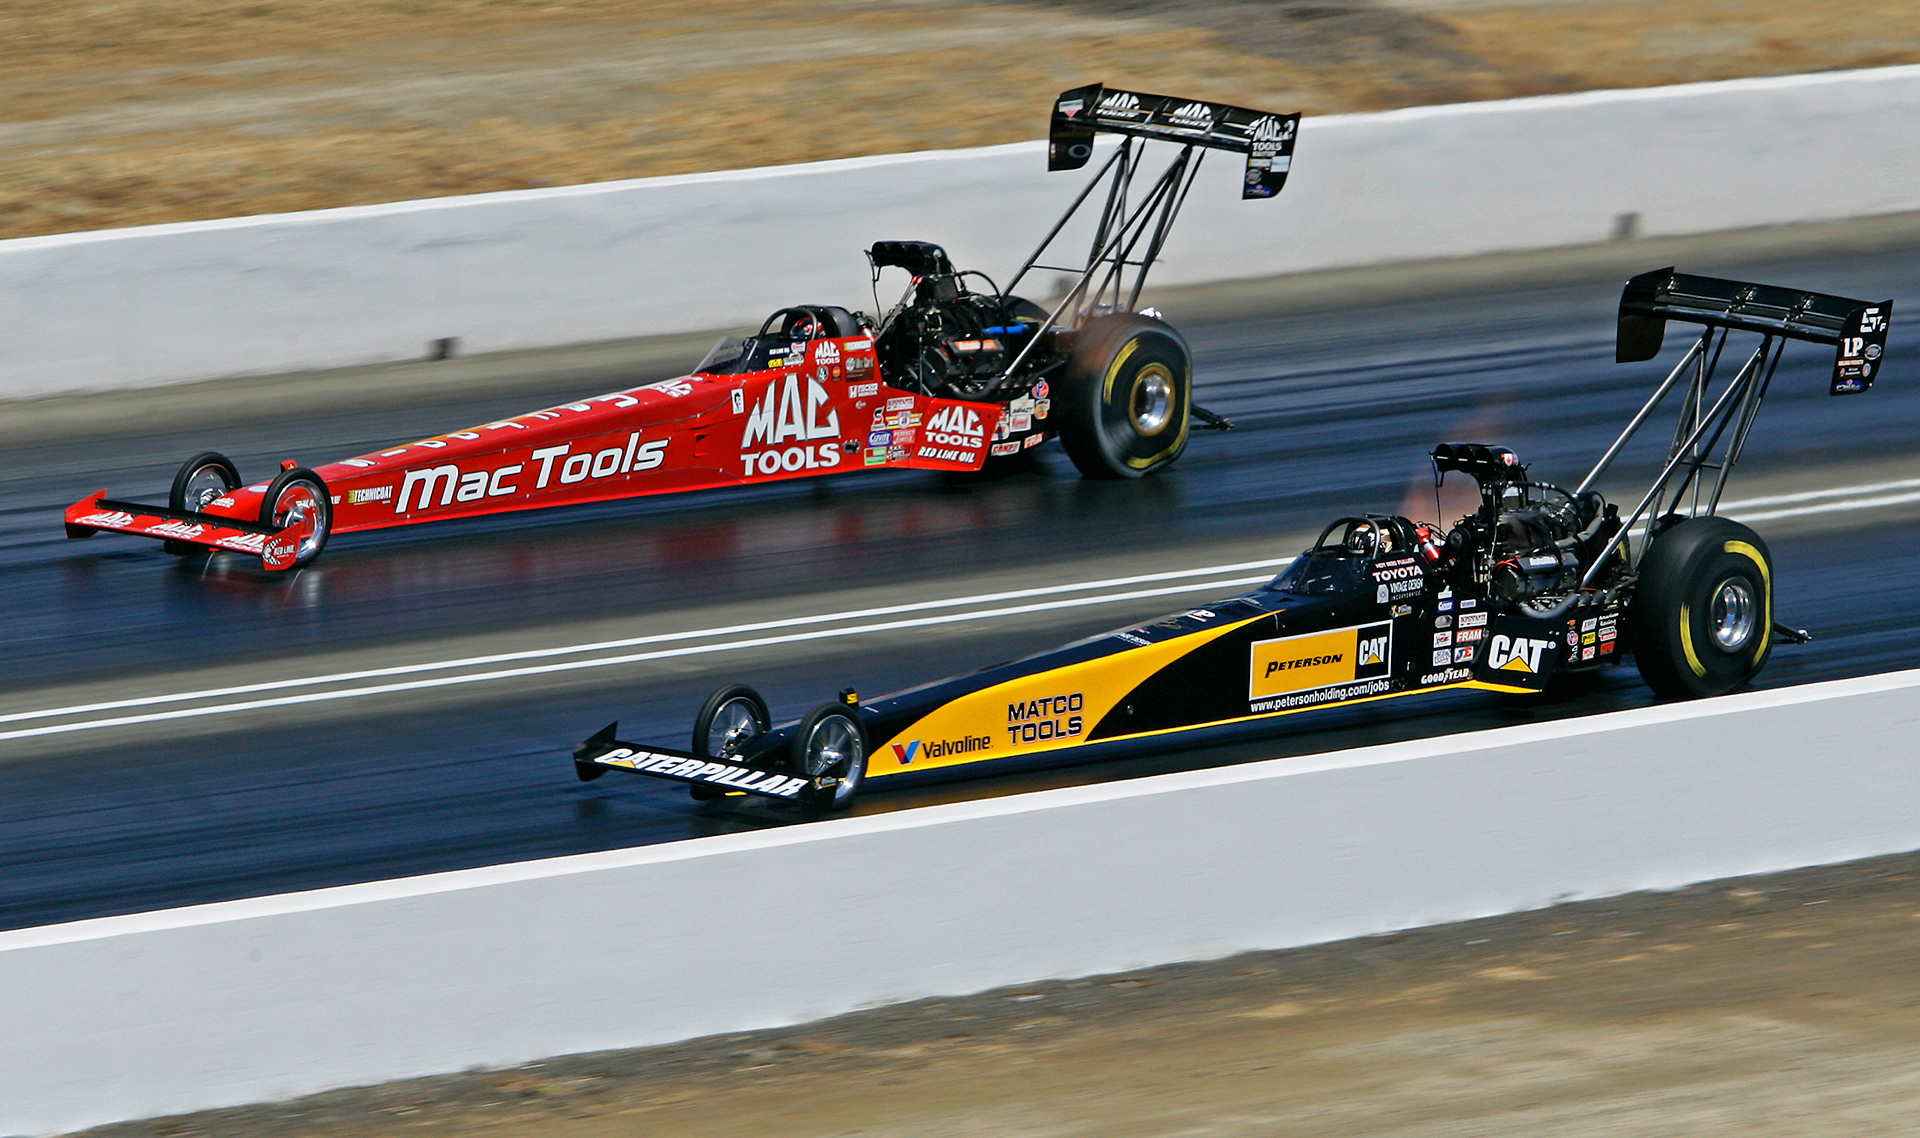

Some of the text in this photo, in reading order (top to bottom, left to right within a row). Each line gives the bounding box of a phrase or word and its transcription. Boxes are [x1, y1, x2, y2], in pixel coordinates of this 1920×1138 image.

[1252, 142, 1282, 151] TOOLS
[815, 340, 840, 358] MAC
[1844, 337, 1864, 358] LP
[816, 356, 840, 366] TOOLS
[741, 372, 841, 450] MAC
[926, 406, 985, 437] MAC
[924, 431, 983, 450] TOOLS
[740, 443, 841, 476] TOOLS
[917, 446, 937, 460] RED
[935, 448, 958, 462] LINE
[957, 452, 976, 464] OIL
[394, 430, 670, 515] Mac Tools
[354, 485, 393, 503] TECHNICOAT
[1372, 565, 1424, 582] TOYOTA
[1457, 629, 1482, 642] FRAM
[1264, 636, 1388, 679] PETERSON CAT
[1456, 647, 1472, 661] JE
[1488, 634, 1548, 674] CAT
[1008, 692, 1083, 723] MATCO
[1251, 680, 1390, 713] www.petersonholding.com/jobs
[1008, 715, 1083, 746] TOOLS
[922, 735, 994, 759] Valvoline
[593, 748, 810, 797] CATERPILLAR
